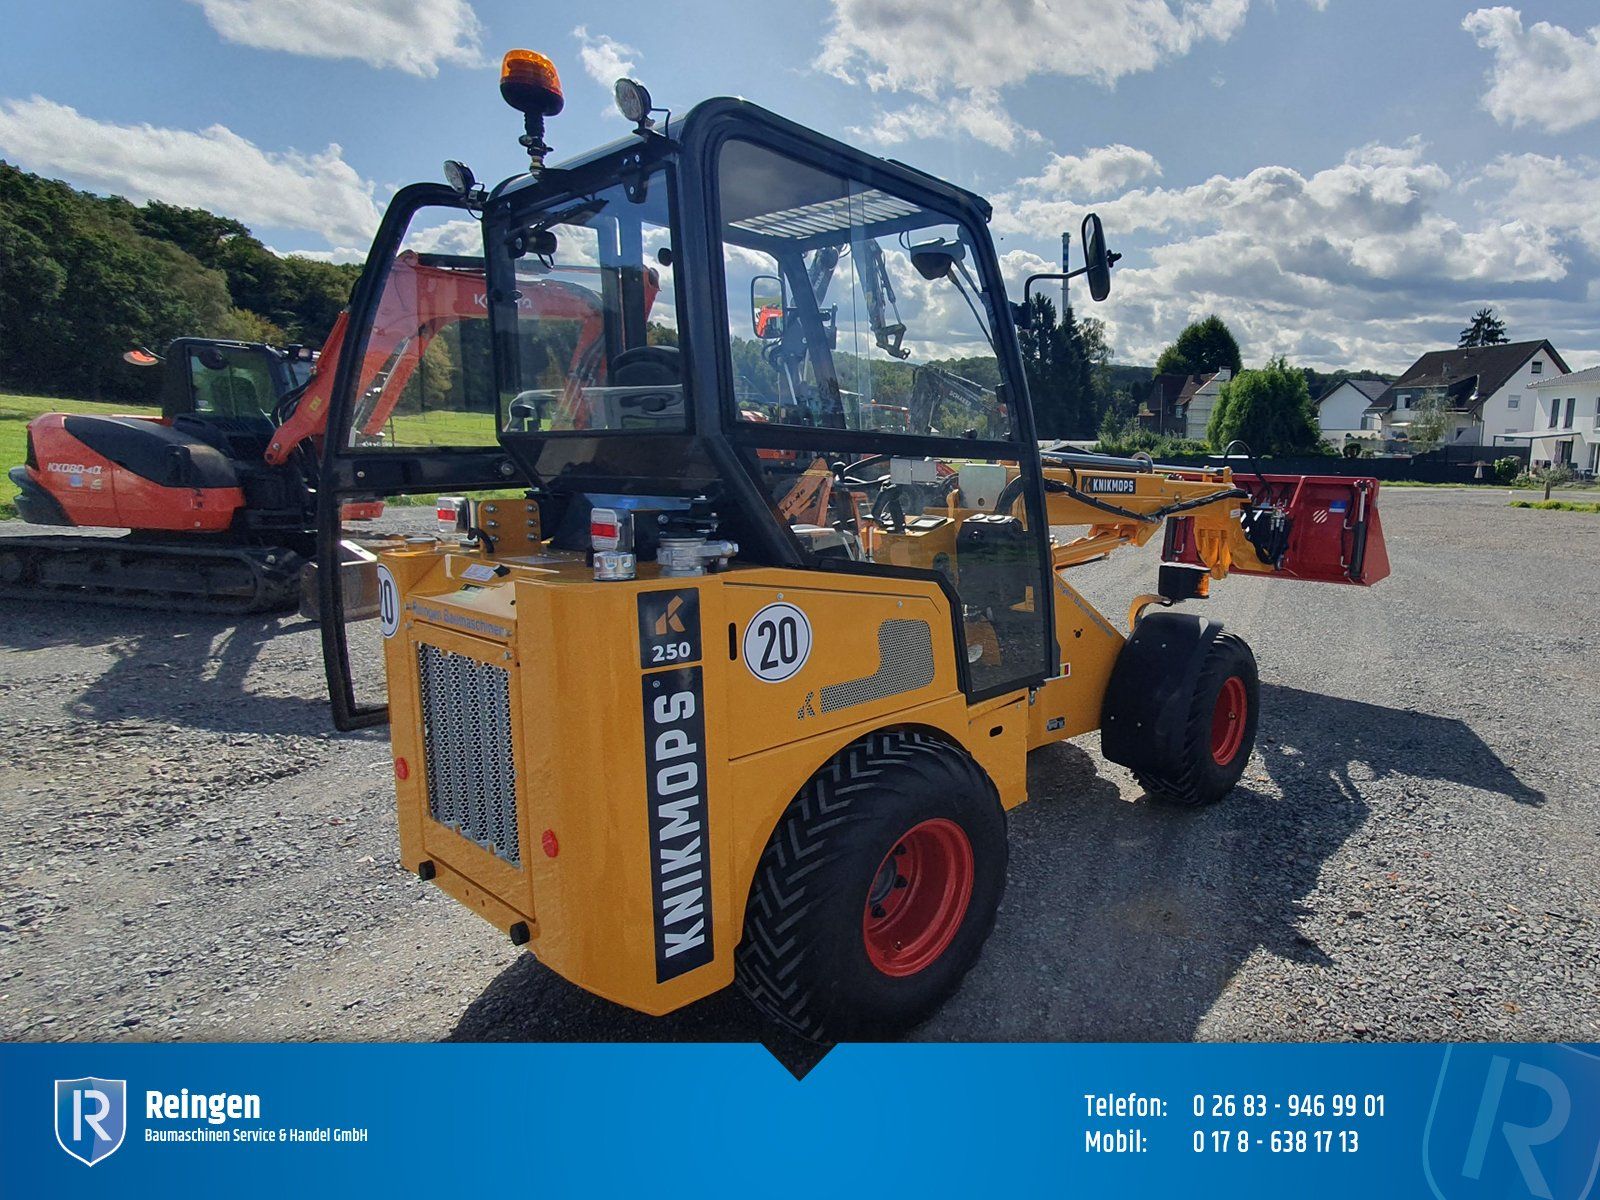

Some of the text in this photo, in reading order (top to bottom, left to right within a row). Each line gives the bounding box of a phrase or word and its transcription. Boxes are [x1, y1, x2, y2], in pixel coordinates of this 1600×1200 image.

[1092, 478, 1134, 492] KNIKMOPS
[652, 641, 691, 663] 250
[757, 616, 798, 671] 20
[653, 690, 705, 959] KNIKMOPS
